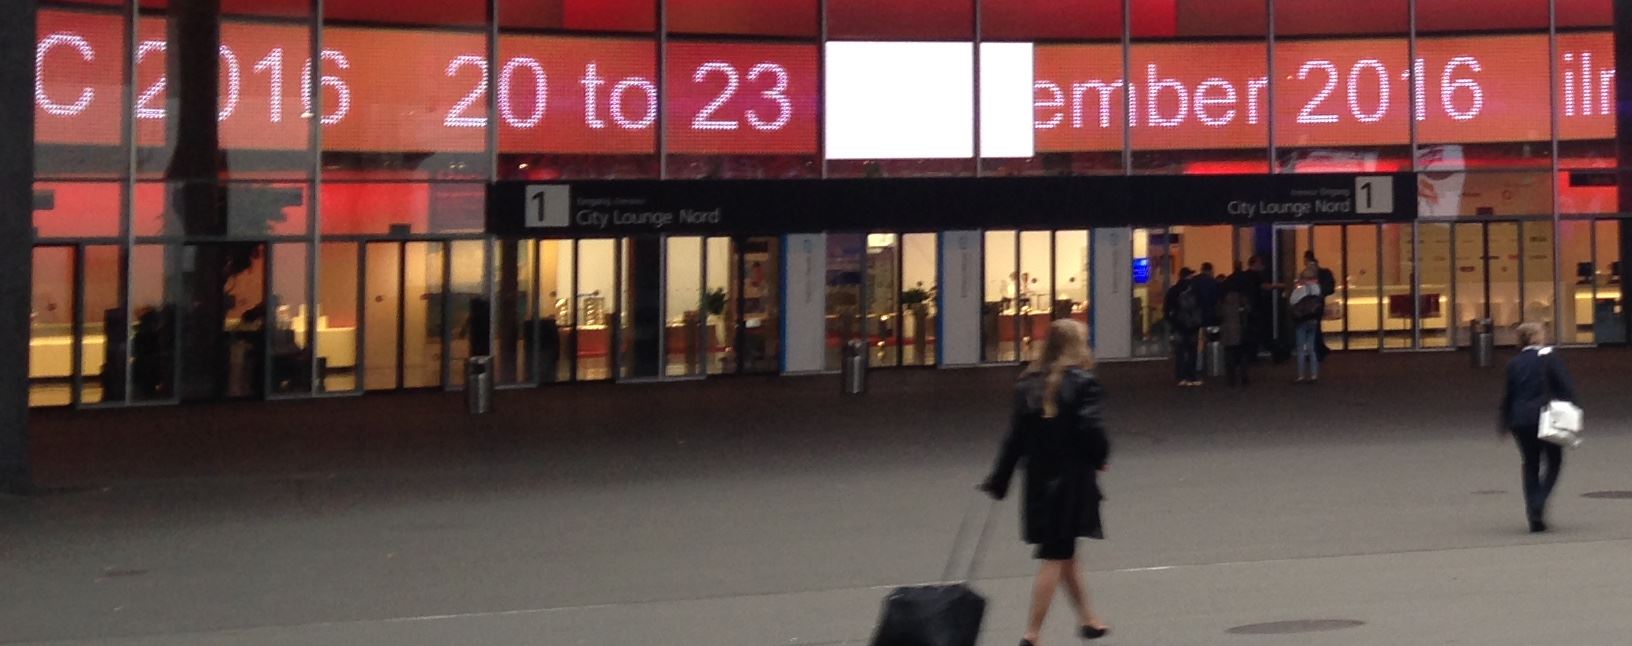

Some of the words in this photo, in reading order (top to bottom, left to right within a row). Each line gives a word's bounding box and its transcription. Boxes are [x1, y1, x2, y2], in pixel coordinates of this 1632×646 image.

[35, 31, 96, 116] C
[443, 55, 548, 129] 20
[580, 59, 658, 130] to
[690, 61, 794, 131] 23
[1296, 56, 1485, 125] 2016
[530, 190, 547, 223] 1
[1226, 200, 1256, 218] City
[1259, 200, 1312, 218] Lounge
[1315, 198, 1351, 213] Nord
[1360, 181, 1373, 209] 1
[575, 209, 610, 229] City
[613, 209, 673, 228] Lounge
[679, 207, 721, 224] Nord
